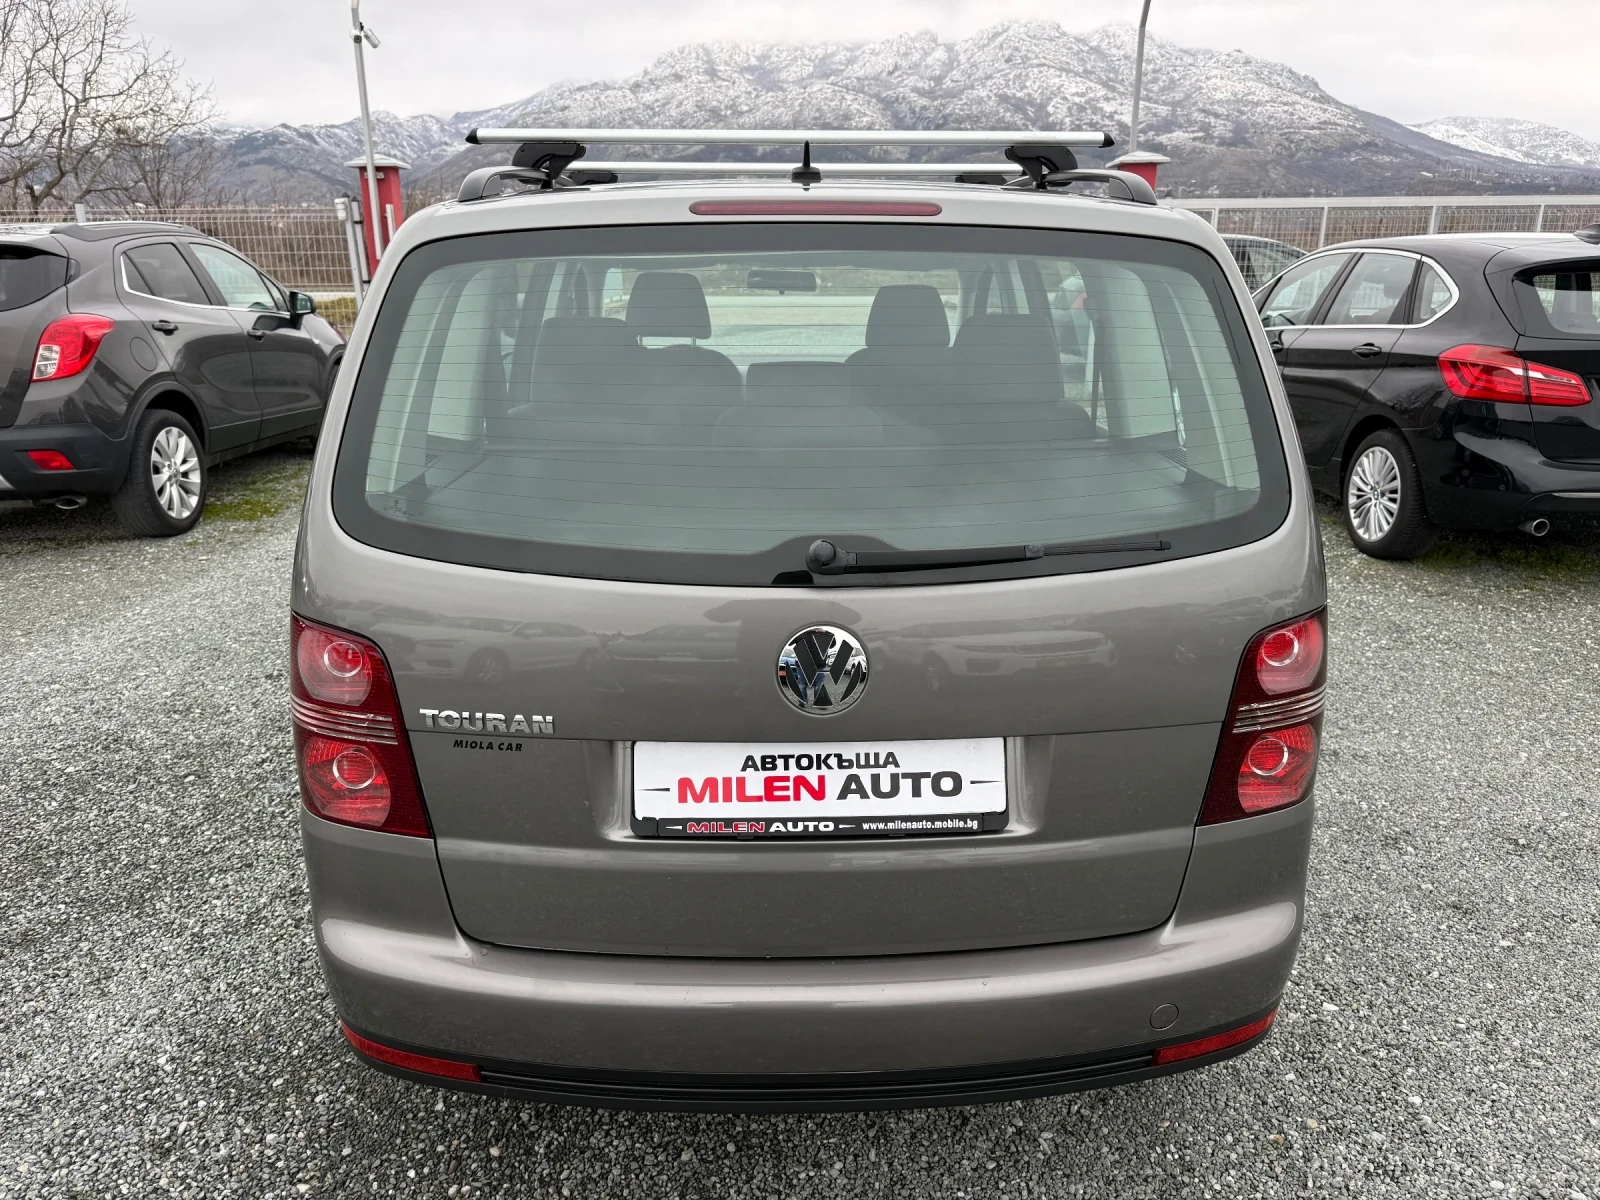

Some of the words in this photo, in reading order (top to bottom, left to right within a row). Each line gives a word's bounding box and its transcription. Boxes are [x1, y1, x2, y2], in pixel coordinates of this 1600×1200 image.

[777, 624, 869, 716] VW
[419, 708, 555, 735] TOURAN
[452, 739, 495, 751] MIOLA
[497, 742, 523, 752] CAR
[677, 774, 827, 804] MILEN
[836, 770, 963, 801] AUTO
[686, 821, 766, 834] MILEN
[768, 821, 835, 833] AUTO
[862, 818, 979, 831] www.milenauto.mobile.bg
